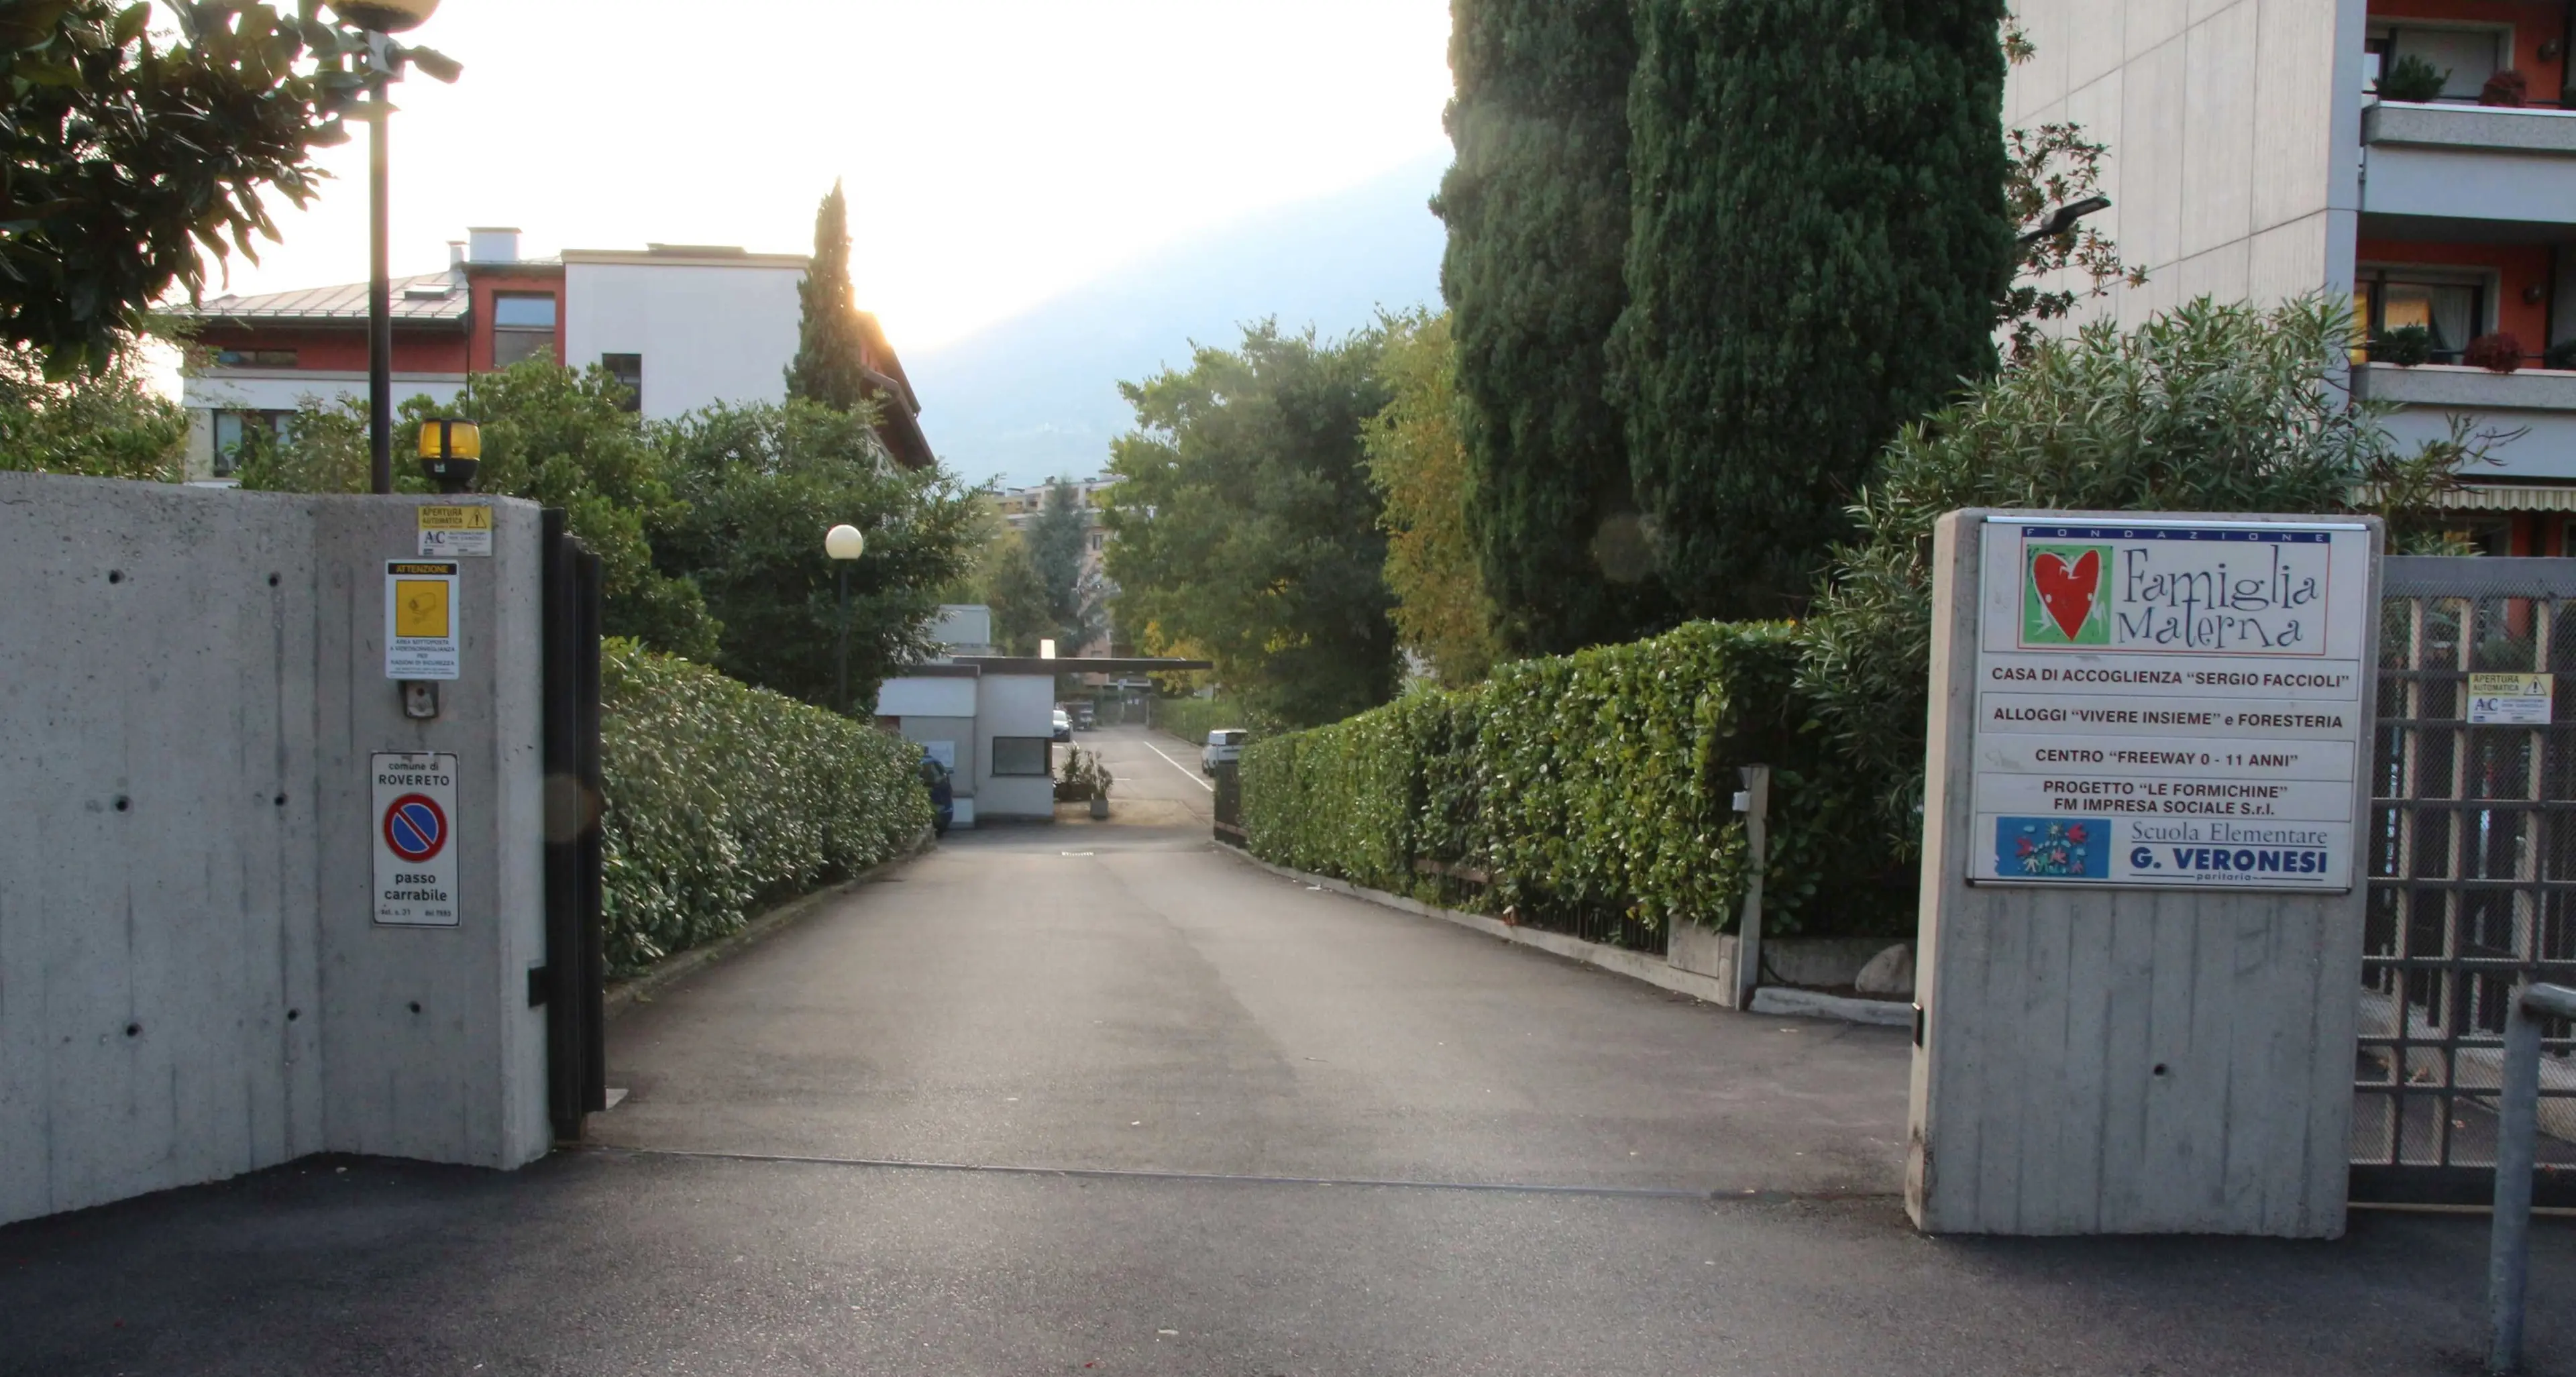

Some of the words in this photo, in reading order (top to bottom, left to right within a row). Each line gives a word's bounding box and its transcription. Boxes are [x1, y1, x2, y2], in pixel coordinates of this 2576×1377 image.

[423, 508, 462, 516] APERTURA
[2027, 529, 2324, 542] FONDAZIONE
[396, 565, 449, 573] ATTENZIONE
[2123, 545, 2319, 611] Famiglia
[2117, 604, 2304, 649] Materna
[1992, 668, 2037, 681] CASA
[2042, 669, 2057, 681] DI
[2063, 669, 2182, 684] ACCOGLIENZA
[2187, 672, 2259, 685] “SERGIO
[2263, 673, 2349, 687] FACCIOLI”
[2473, 675, 2519, 683] APERTURA
[1994, 708, 2066, 721] ALLOGGI
[2072, 710, 2138, 723] “VIVERE
[2143, 711, 2220, 724] INSIEME”
[2224, 716, 2234, 726] e
[2238, 714, 2343, 728] FORESTERIA
[430, 761, 439, 771] di
[2035, 749, 2104, 763] CENTRO
[2109, 751, 2196, 765] “FREEWAY
[2200, 753, 2210, 765] 0
[2226, 754, 2243, 766] 11
[2249, 754, 2298, 767] ANNI”
[378, 775, 449, 786] ROVERETO
[2043, 781, 2133, 795] PROGETTO
[2174, 783, 2288, 798] FORMICHINE”
[2054, 798, 2077, 810] FM
[2084, 799, 2157, 813] IMPRESA
[2163, 800, 2235, 814] SOCIALE
[2241, 802, 2275, 815] S.r.l.
[2132, 820, 2198, 841] Scuola
[2210, 822, 2328, 844] Elementare
[2130, 846, 2161, 869] G.
[2172, 848, 2327, 873] VERONESI
[395, 873, 436, 885] passo
[384, 889, 447, 901] carrabile
